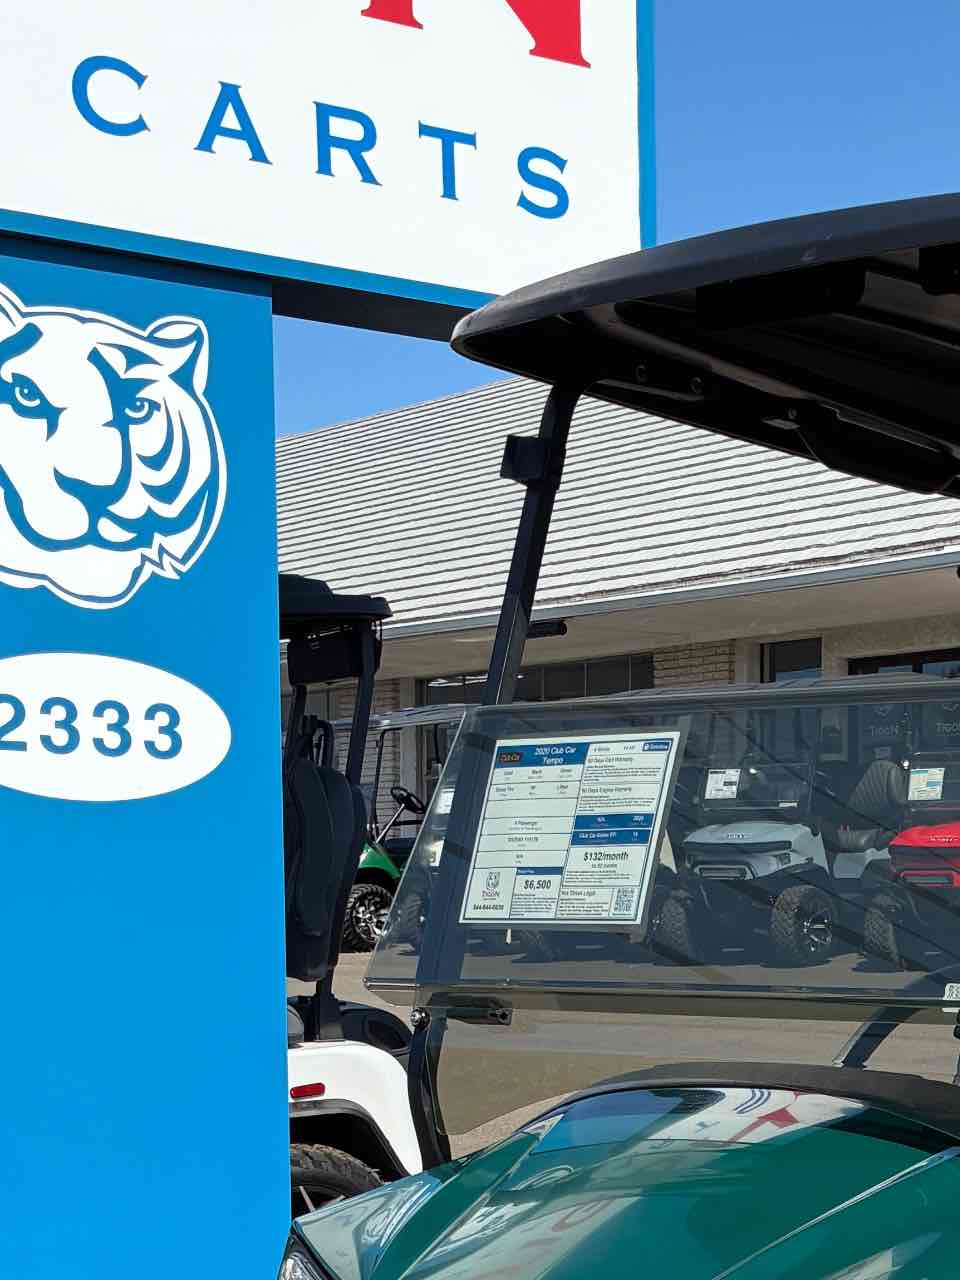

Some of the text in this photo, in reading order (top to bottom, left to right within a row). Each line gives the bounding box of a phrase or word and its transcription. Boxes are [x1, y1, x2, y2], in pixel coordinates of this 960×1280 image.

[71, 55, 570, 220] CARTS
[0, 693, 183, 760] 2333
[583, 851, 629, 862] $132/month
[524, 879, 552, 891] $6,500
